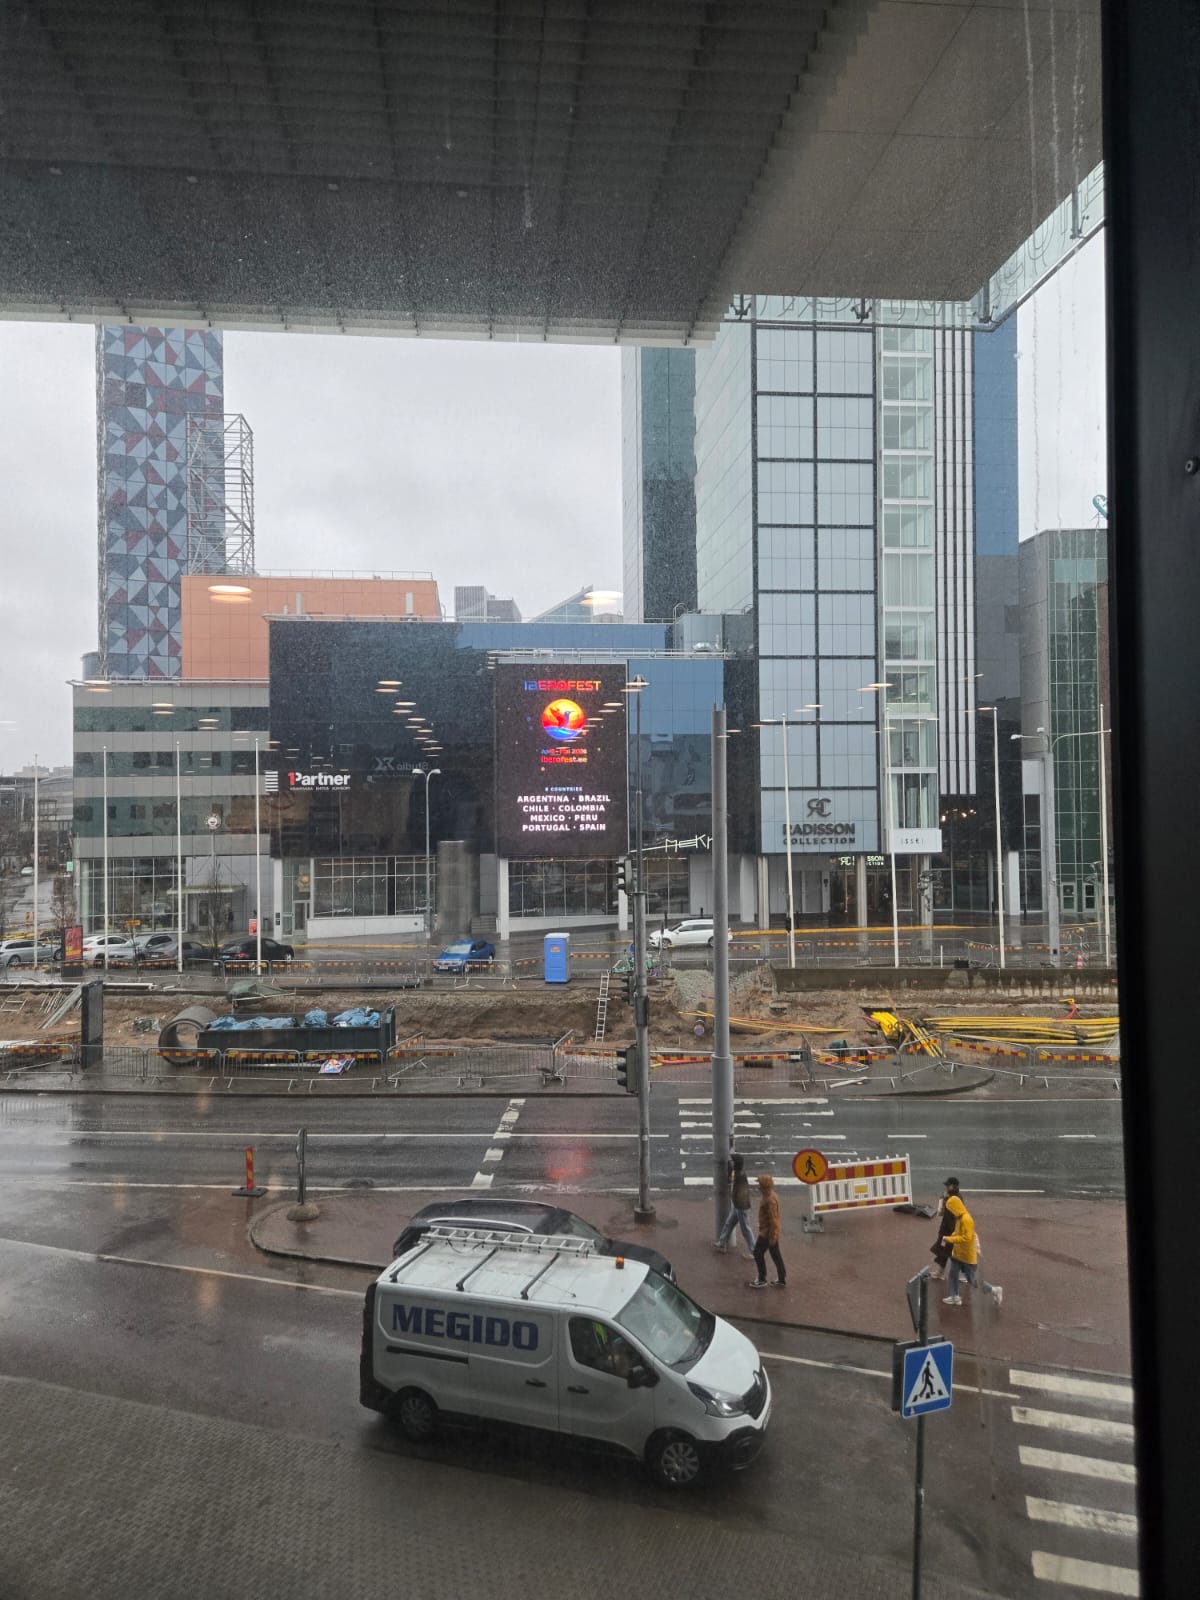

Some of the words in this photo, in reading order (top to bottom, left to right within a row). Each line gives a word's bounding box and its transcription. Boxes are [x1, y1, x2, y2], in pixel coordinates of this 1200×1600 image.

[524, 680, 602, 691] IBEROFEST
[288, 771, 351, 786] 1Partner
[517, 795, 569, 803] ARGENTINA
[574, 814, 598, 822] PERU
[522, 824, 570, 832] PORTUGAL
[783, 823, 855, 836] RADISSON
[391, 1303, 539, 1351] MEGIDO
